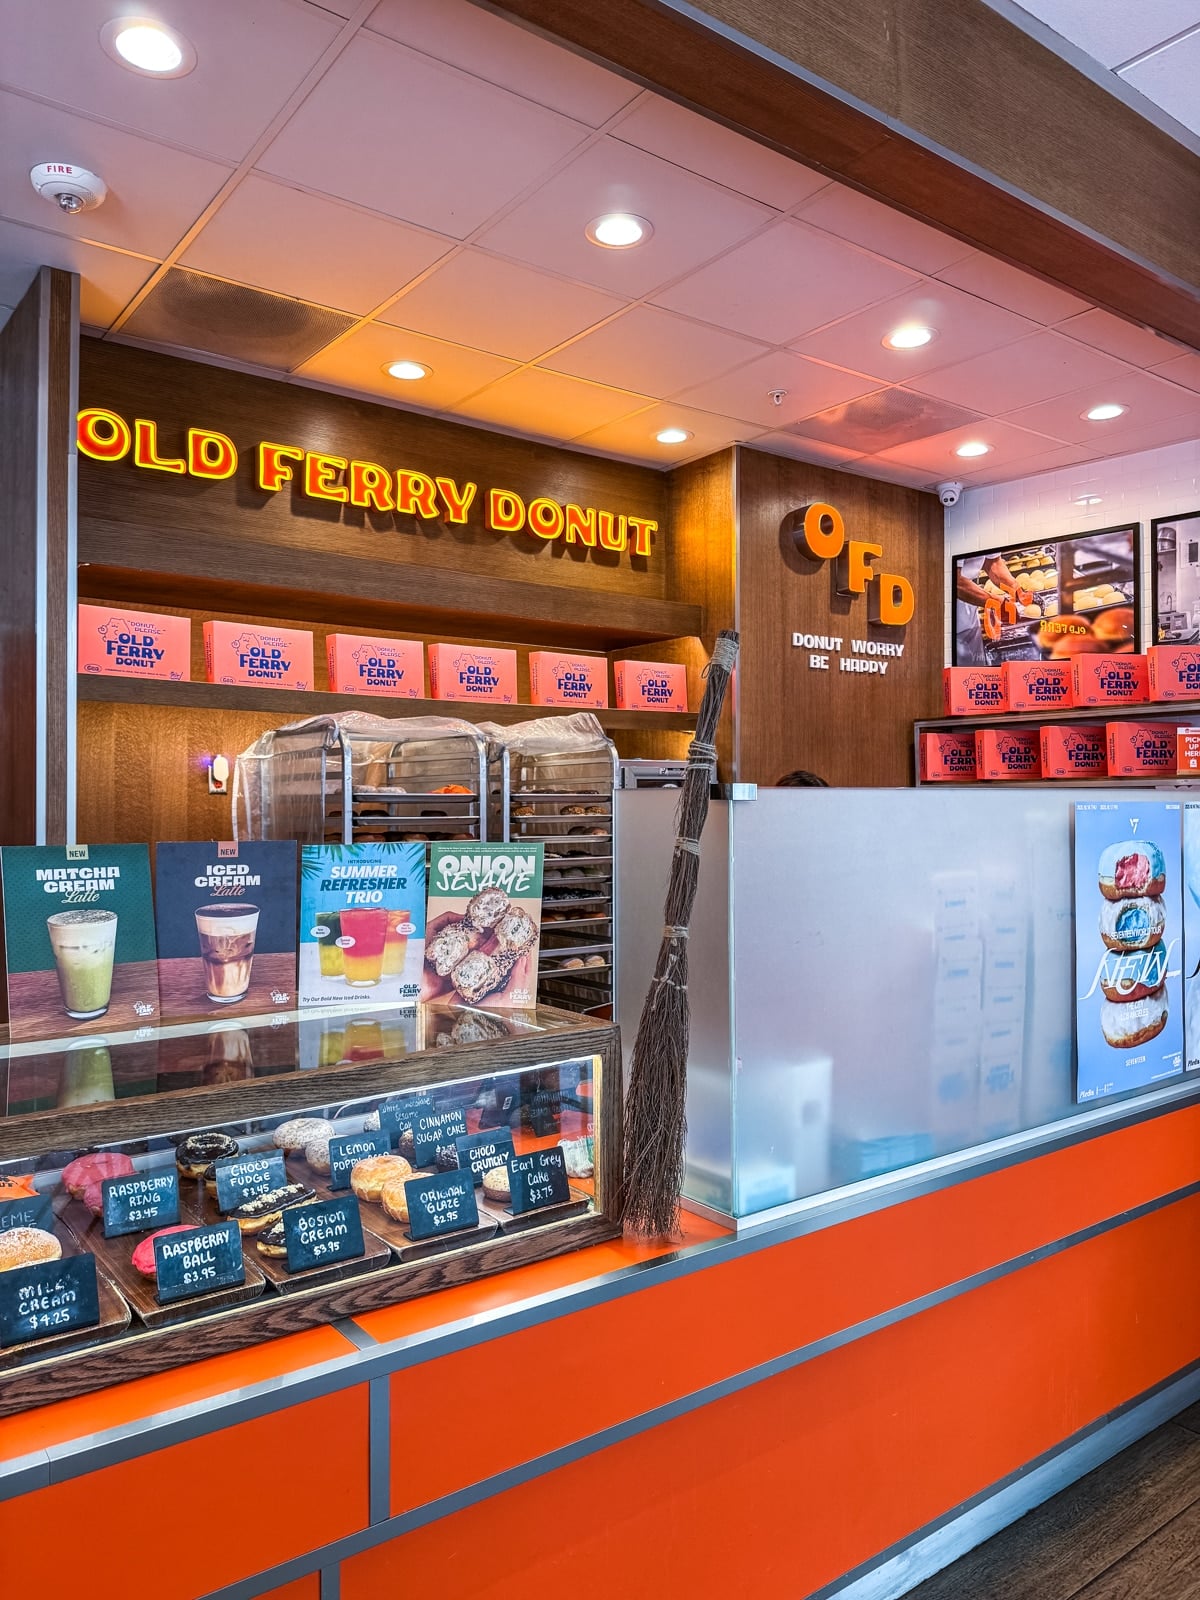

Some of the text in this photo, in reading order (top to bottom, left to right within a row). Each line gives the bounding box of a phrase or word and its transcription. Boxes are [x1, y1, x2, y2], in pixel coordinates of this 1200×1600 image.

[47, 165, 73, 174] FIRE
[76, 407, 658, 557] OLD FERRY DONUT
[804, 501, 914, 625] OFD
[118, 633, 154, 646] OLD
[792, 632, 904, 657] DONUT WORRY
[106, 640, 165, 660] FERRY
[249, 647, 281, 659] OLD
[115, 657, 155, 668] DONUT
[240, 654, 291, 671] FERRY
[368, 657, 396, 668] OLD
[809, 654, 888, 675] BE HAPPY
[248, 670, 283, 679] DONUT
[359, 664, 404, 679] FERRY
[467, 666, 492, 675] OLD
[565, 672, 586, 682] OLD
[1108, 671, 1132, 680] OLD
[367, 678, 397, 687] DONUT
[459, 672, 499, 686] FERRY
[557, 678, 593, 692] FERRY
[648, 679, 667, 688] OLD
[1036, 677, 1061, 685] OLD
[1100, 678, 1139, 689] FERRY
[466, 685, 493, 693] DONUT
[641, 685, 674, 697] FERRY
[976, 683, 998, 691] OLD
[1028, 683, 1069, 695] FERRY
[1009, 746, 1031, 754] OLD
[1076, 743, 1099, 752] OLD
[1143, 740, 1168, 749] OLD
[1001, 752, 1038, 763] FERRY
[1068, 749, 1106, 761] FERRY
[1136, 747, 1176, 758] FERRY
[69, 850, 86, 858] NEW
[206, 864, 250, 876] ICED
[330, 865, 398, 878] SUMMER
[438, 855, 536, 877] ONION
[36, 866, 120, 881] MATCHA
[43, 879, 115, 893] CREAM
[194, 875, 261, 888] CREAM
[320, 877, 407, 891] REFRESHER
[436, 870, 534, 893] SESAME
[61, 888, 101, 904] Latte
[210, 884, 246, 896] Latte
[345, 890, 383, 904] TRIO
[399, 1121, 411, 1131] Cak
[420, 1110, 462, 1130] CINNAMON
[416, 1124, 466, 1145] SUGAR CAKE
[340, 1142, 376, 1156] LEMON
[470, 1144, 496, 1160] CHOCO
[230, 1160, 269, 1176] CHOCO
[471, 1152, 509, 1173] CRUNCHY
[511, 1154, 561, 1173] Earl Grey
[108, 1175, 173, 1198] RASPBERRY
[230, 1172, 271, 1187] FUDGE
[242, 1183, 269, 1198] $3.45
[529, 1185, 553, 1203] $3.75
[129, 1192, 161, 1207] RING
[427, 1198, 460, 1214] GLAZE
[129, 1206, 158, 1221] $3.45
[433, 1211, 458, 1226] $2.95
[300, 1224, 348, 1244] CREAM
[162, 1230, 229, 1259] RASPBERRY
[183, 1250, 216, 1269] BALL
[183, 1266, 216, 1284] $3.95
[19, 1291, 76, 1315] CREAM
[29, 1308, 70, 1329] $4.25
